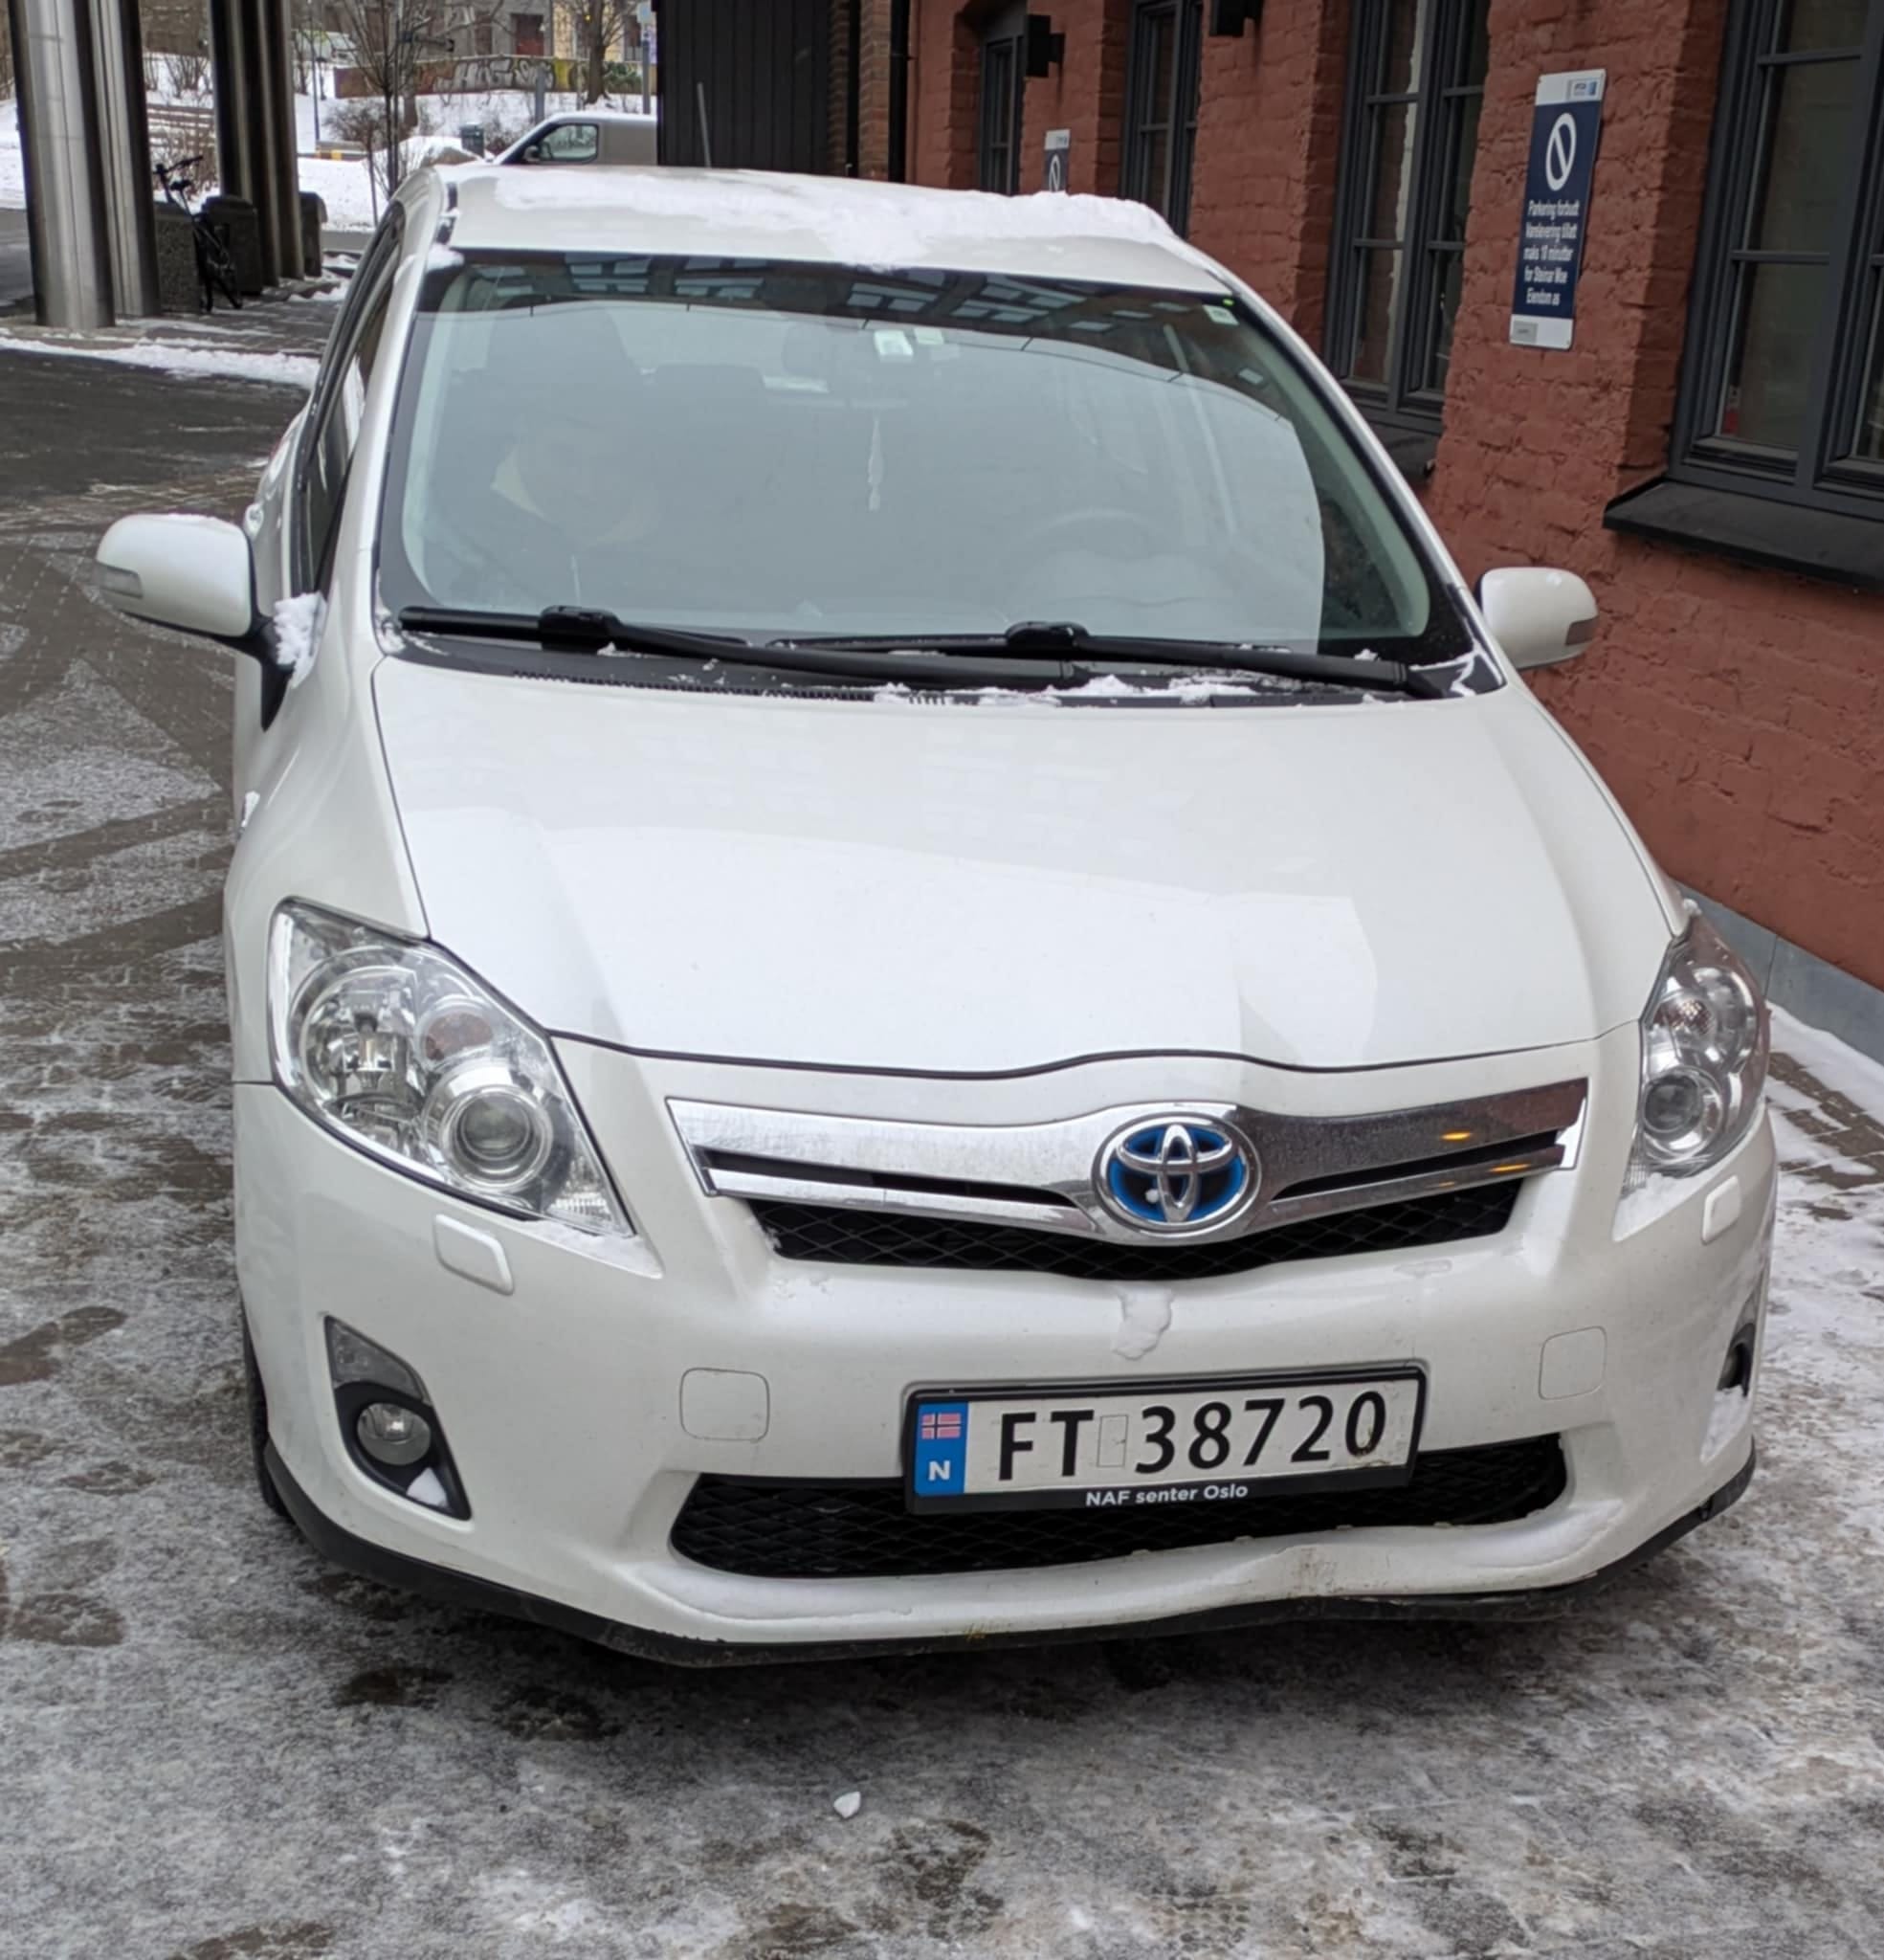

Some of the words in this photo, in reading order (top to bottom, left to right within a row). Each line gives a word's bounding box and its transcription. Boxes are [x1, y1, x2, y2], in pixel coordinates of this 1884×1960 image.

[1527, 199, 1557, 221] Parkering
[1524, 266, 1533, 282] for
[999, 1409, 1095, 1481] FT
[1135, 1391, 1386, 1475] 38720
[927, 1460, 951, 1481] N
[1085, 1491, 1130, 1507] NAF
[1136, 1485, 1198, 1504] senter
[1204, 1482, 1249, 1501] Oslo
